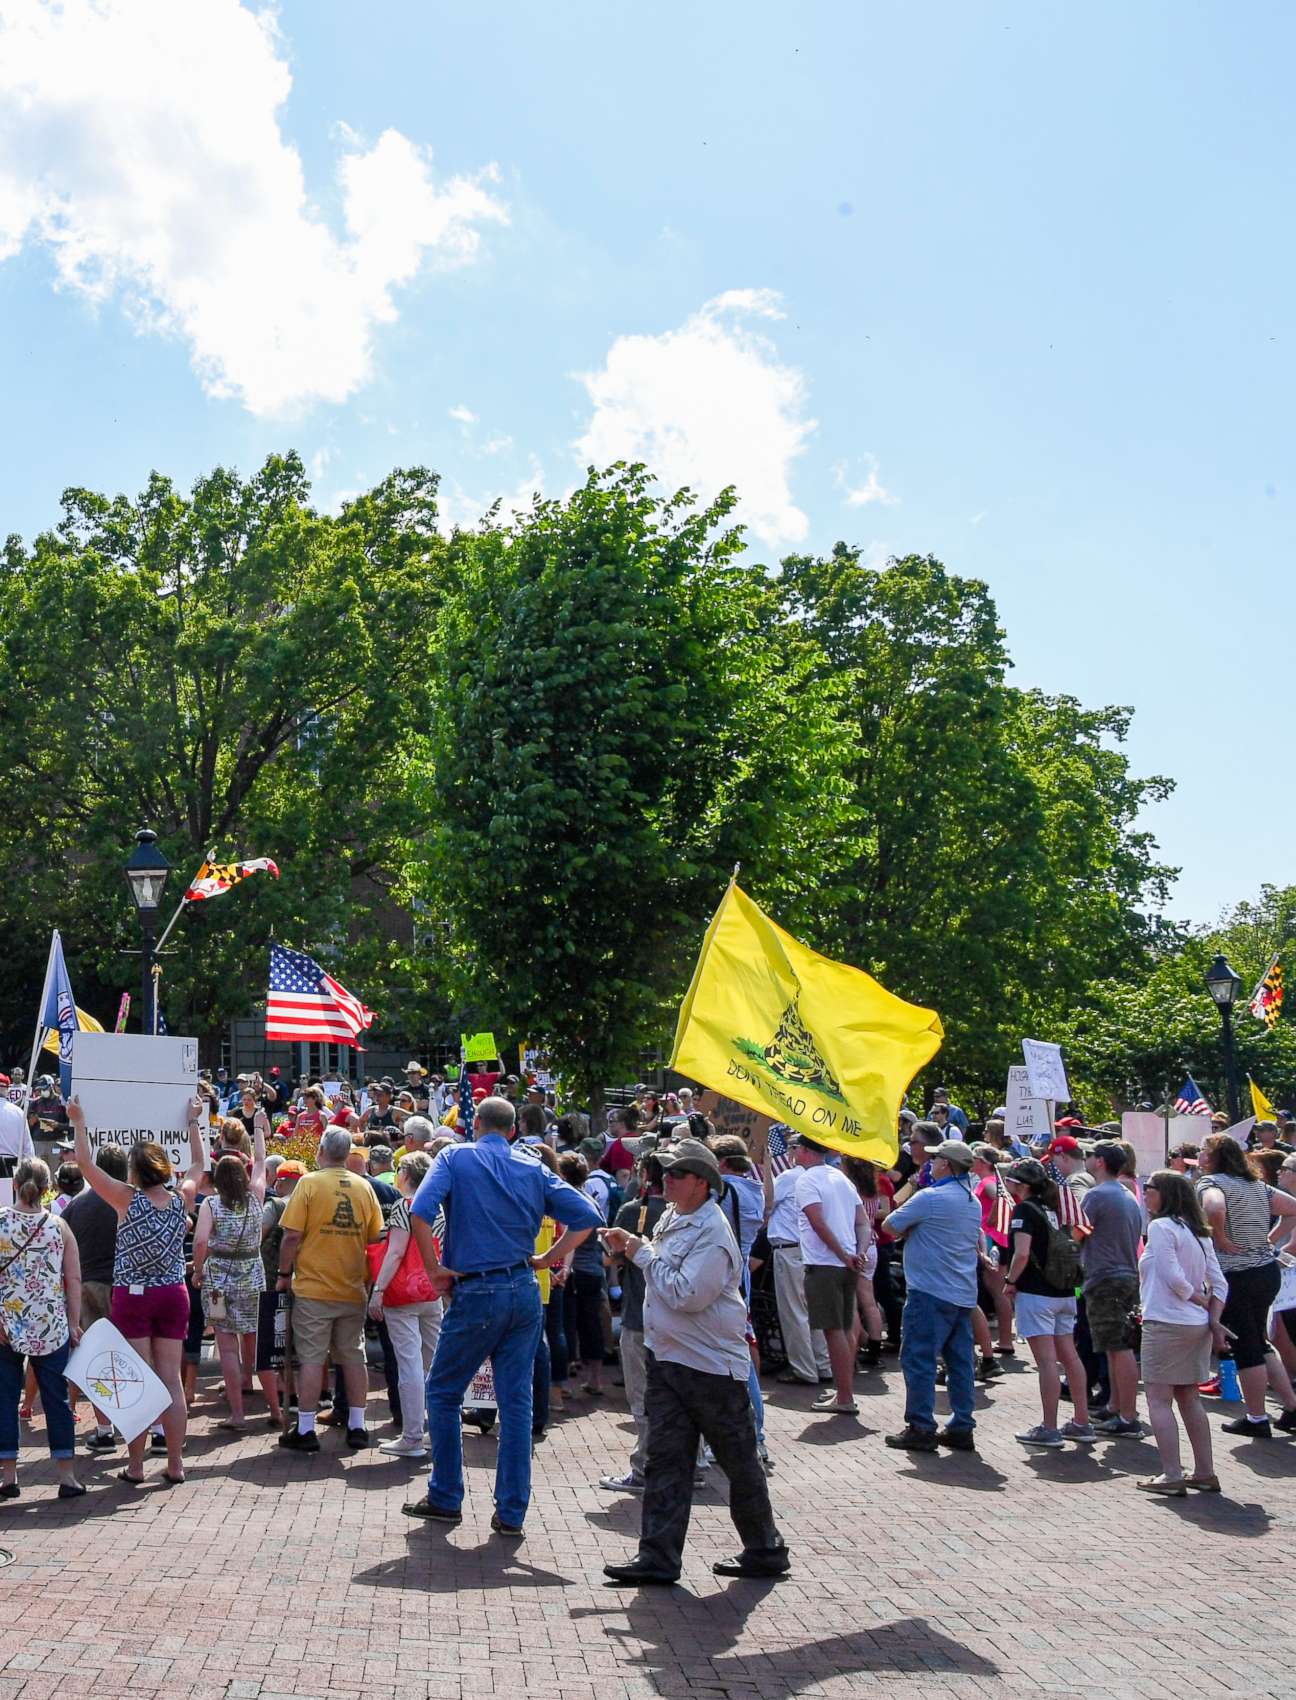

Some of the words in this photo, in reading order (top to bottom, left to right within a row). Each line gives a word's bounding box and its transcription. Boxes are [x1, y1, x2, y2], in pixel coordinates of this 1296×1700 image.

[811, 1106, 838, 1127] ON
[841, 1115, 863, 1138] ME
[1016, 1114, 1034, 1126] LIAR
